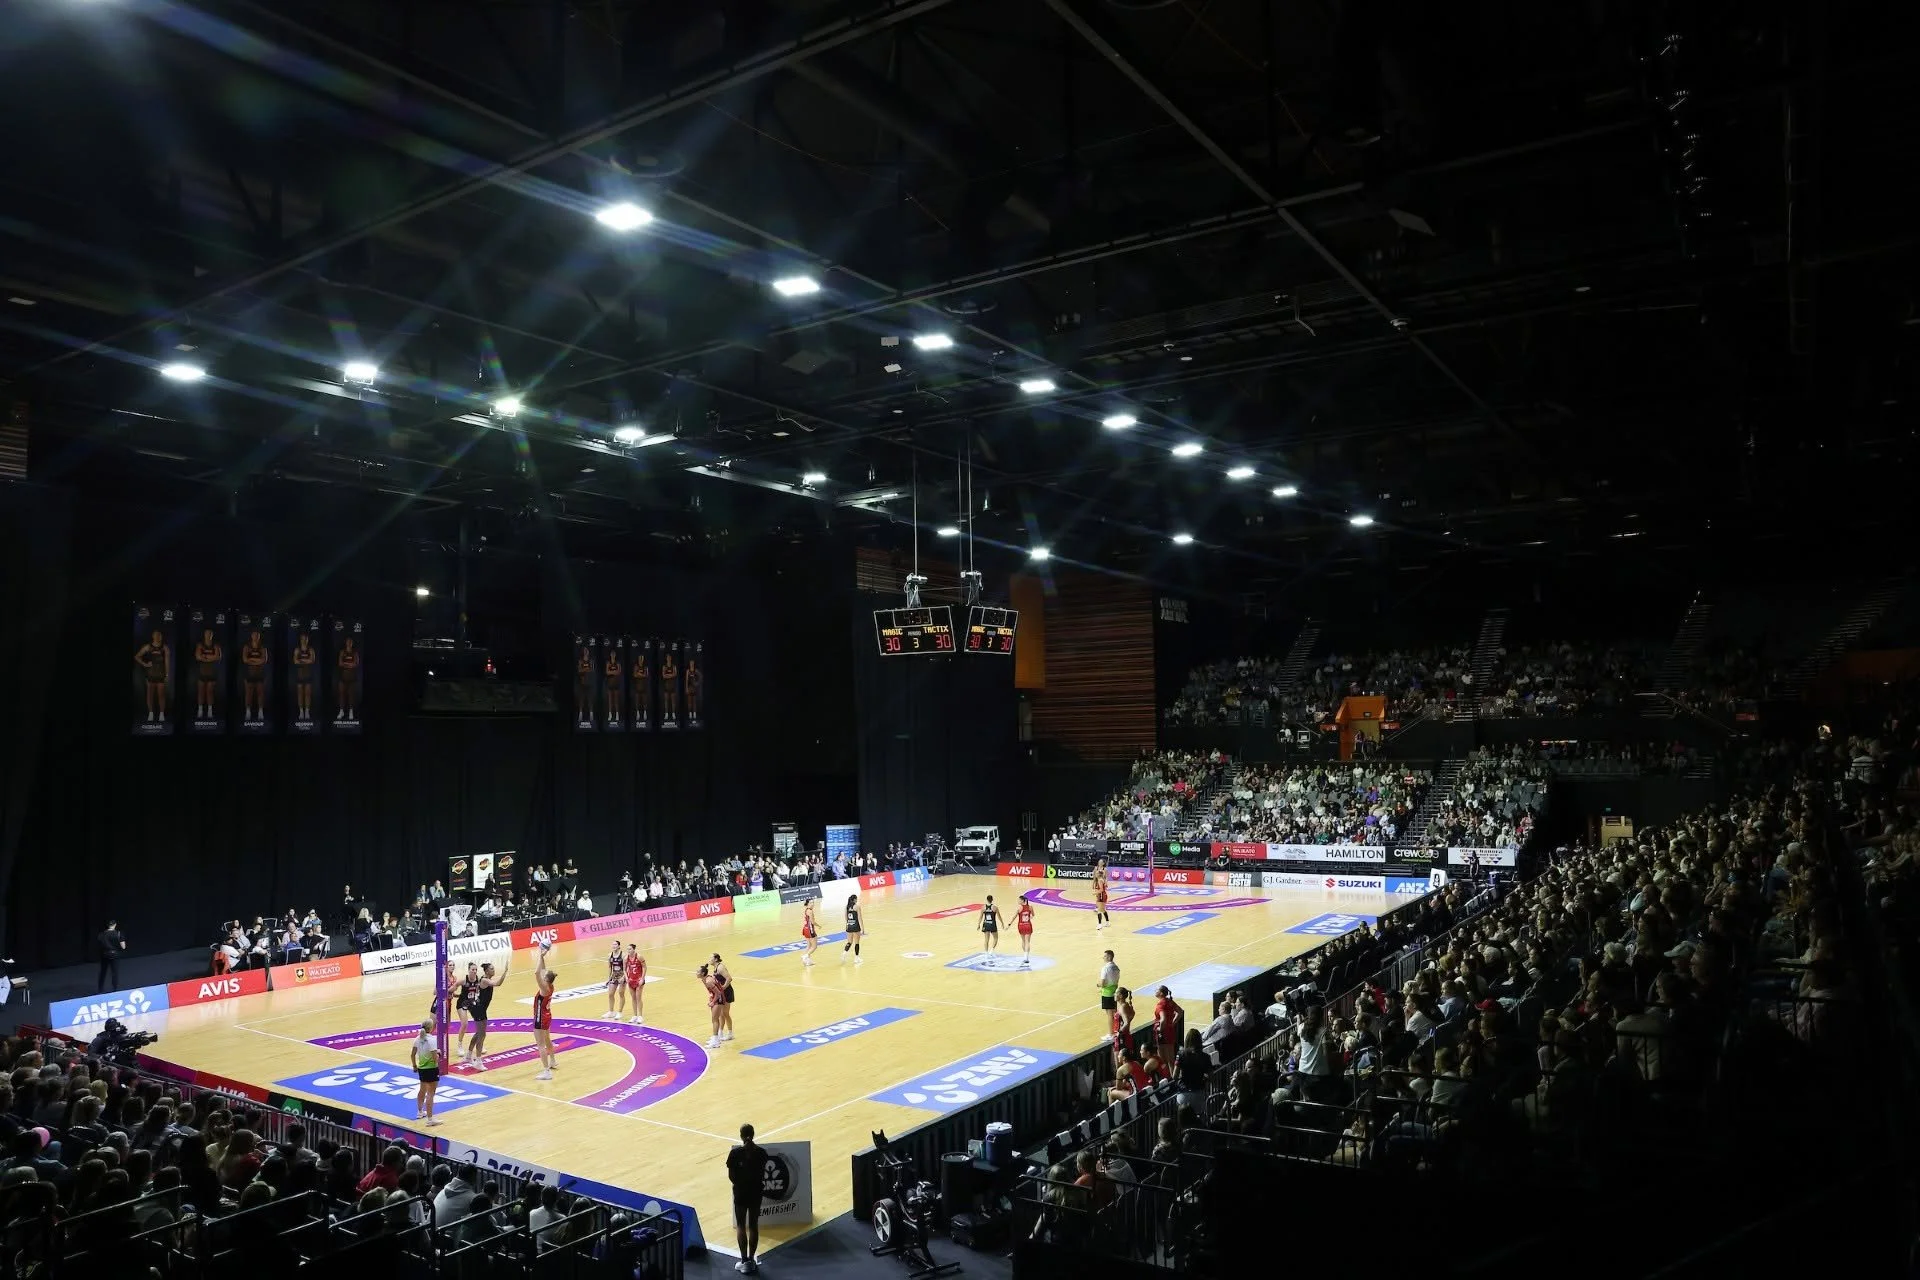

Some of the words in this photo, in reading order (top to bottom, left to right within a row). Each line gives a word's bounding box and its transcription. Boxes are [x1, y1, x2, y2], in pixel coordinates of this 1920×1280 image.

[923, 625, 949, 634] TACTIX
[885, 637, 901, 651] 30
[912, 638, 920, 648] 3
[935, 634, 951, 649] 30
[987, 637, 993, 648] 3
[1182, 845, 1200, 853] Media
[1325, 849, 1384, 859] HAMILTON
[1009, 866, 1031, 875] AVIS
[868, 876, 886, 887] AVIS
[1164, 872, 1188, 882] AVIS
[1338, 879, 1382, 888] SUZUKI
[1394, 882, 1425, 893] ANZ
[699, 902, 720, 915] AVIS
[646, 909, 684, 923] GILBERT
[589, 918, 631, 933] GILBERT
[530, 928, 558, 945] AVIS
[308, 965, 341, 977] WAIKATO
[198, 977, 241, 999] AVIS
[72, 1000, 125, 1025] ANZ
[560, 1022, 622, 1034] SUPER
[624, 1031, 686, 1064] SUMMERSET
[942, 1049, 1039, 1087] ANZ
[600, 1073, 668, 1109] Summerset
